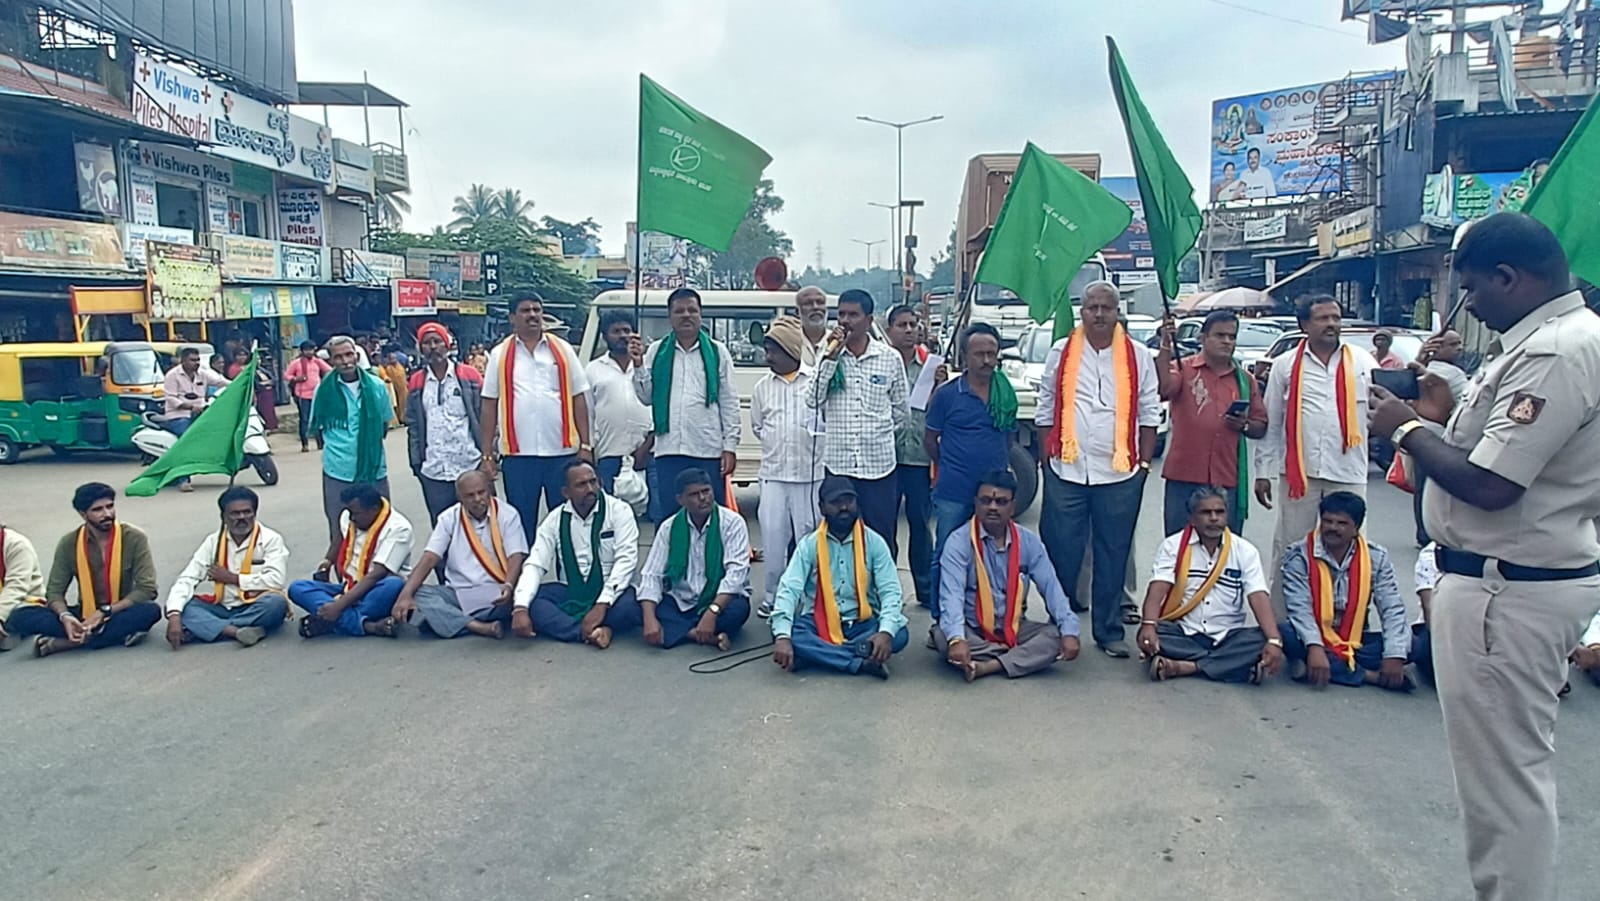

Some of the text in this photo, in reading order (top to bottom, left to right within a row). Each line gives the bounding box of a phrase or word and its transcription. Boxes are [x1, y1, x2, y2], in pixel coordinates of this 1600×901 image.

[153, 68, 200, 104] Vishwa
[135, 91, 212, 143] Piles Hospital
[151, 151, 200, 177] Vishwa
[203, 164, 231, 185] Piles
[287, 223, 316, 235] Piles
